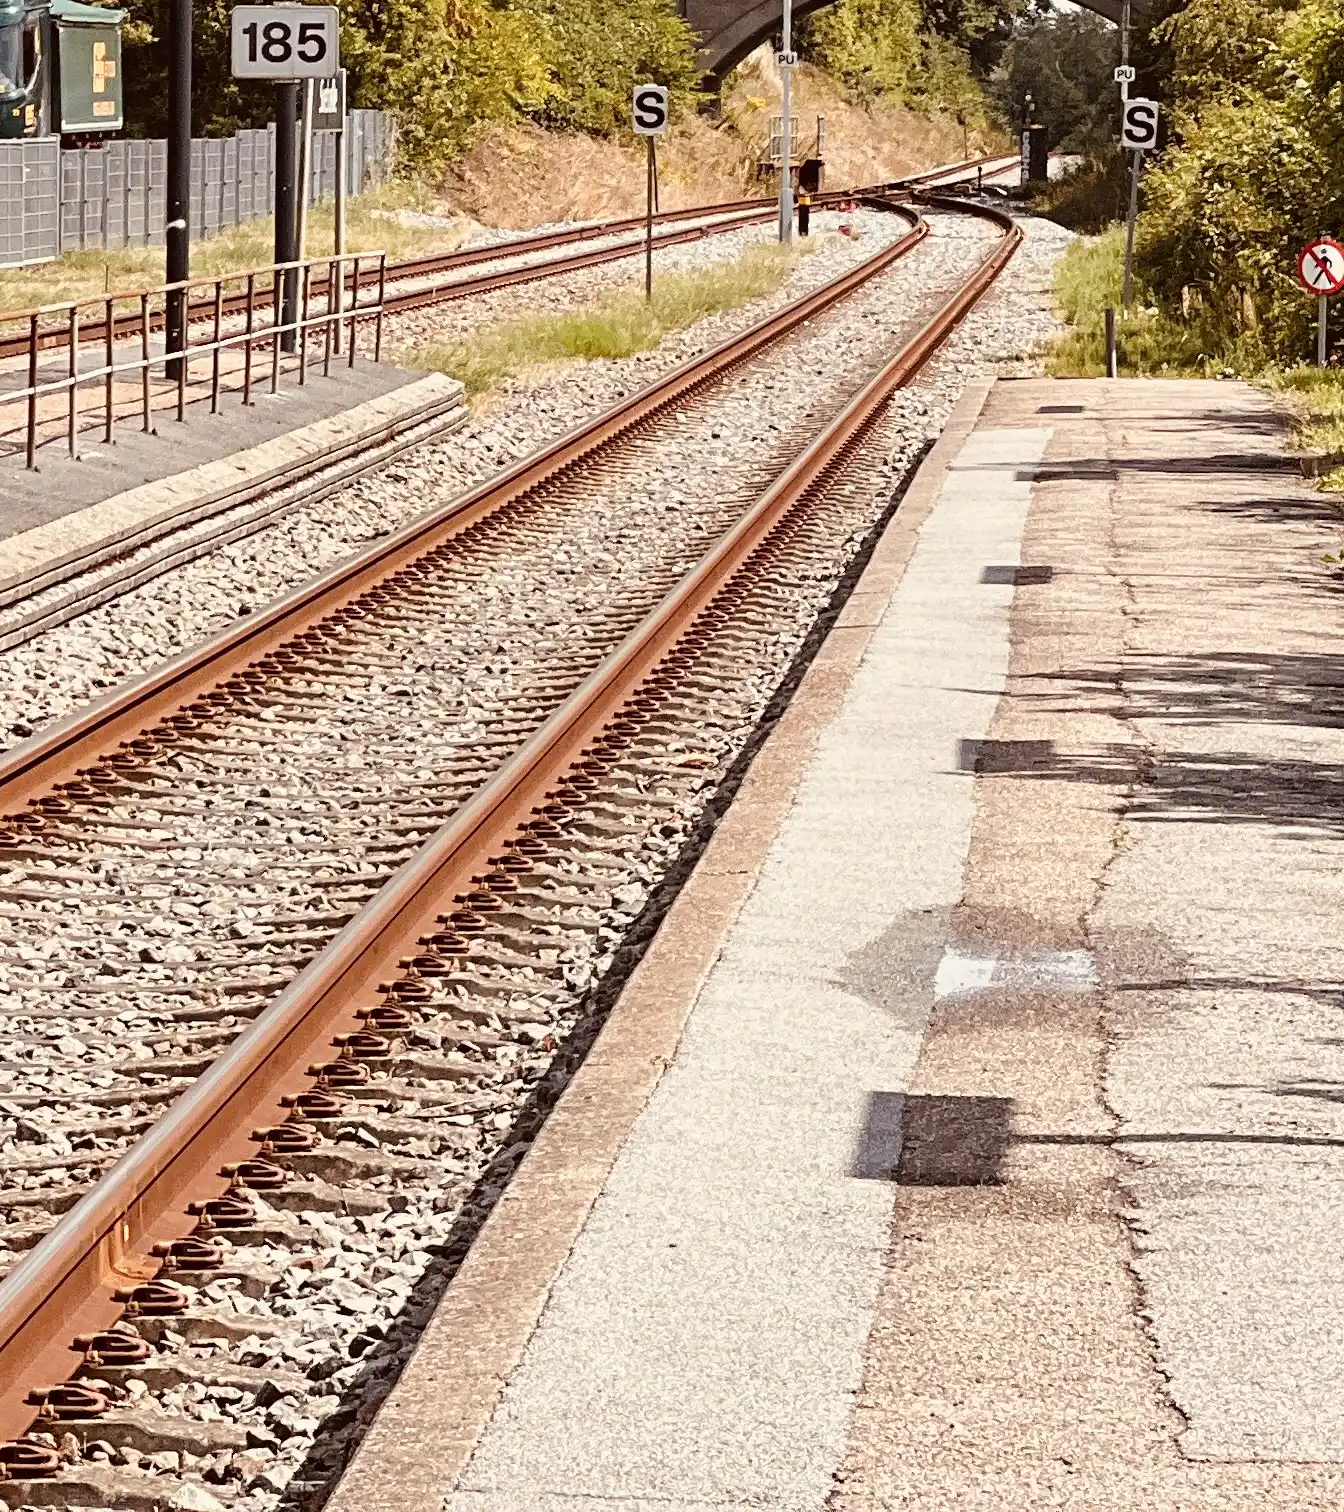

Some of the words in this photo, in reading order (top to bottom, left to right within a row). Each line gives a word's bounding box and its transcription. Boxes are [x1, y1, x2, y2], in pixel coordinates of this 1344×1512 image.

[243, 21, 326, 63] 185
[778, 54, 794, 64] PU
[1117, 70, 1133, 79] PU
[635, 91, 665, 128] S
[1125, 106, 1155, 143] S
